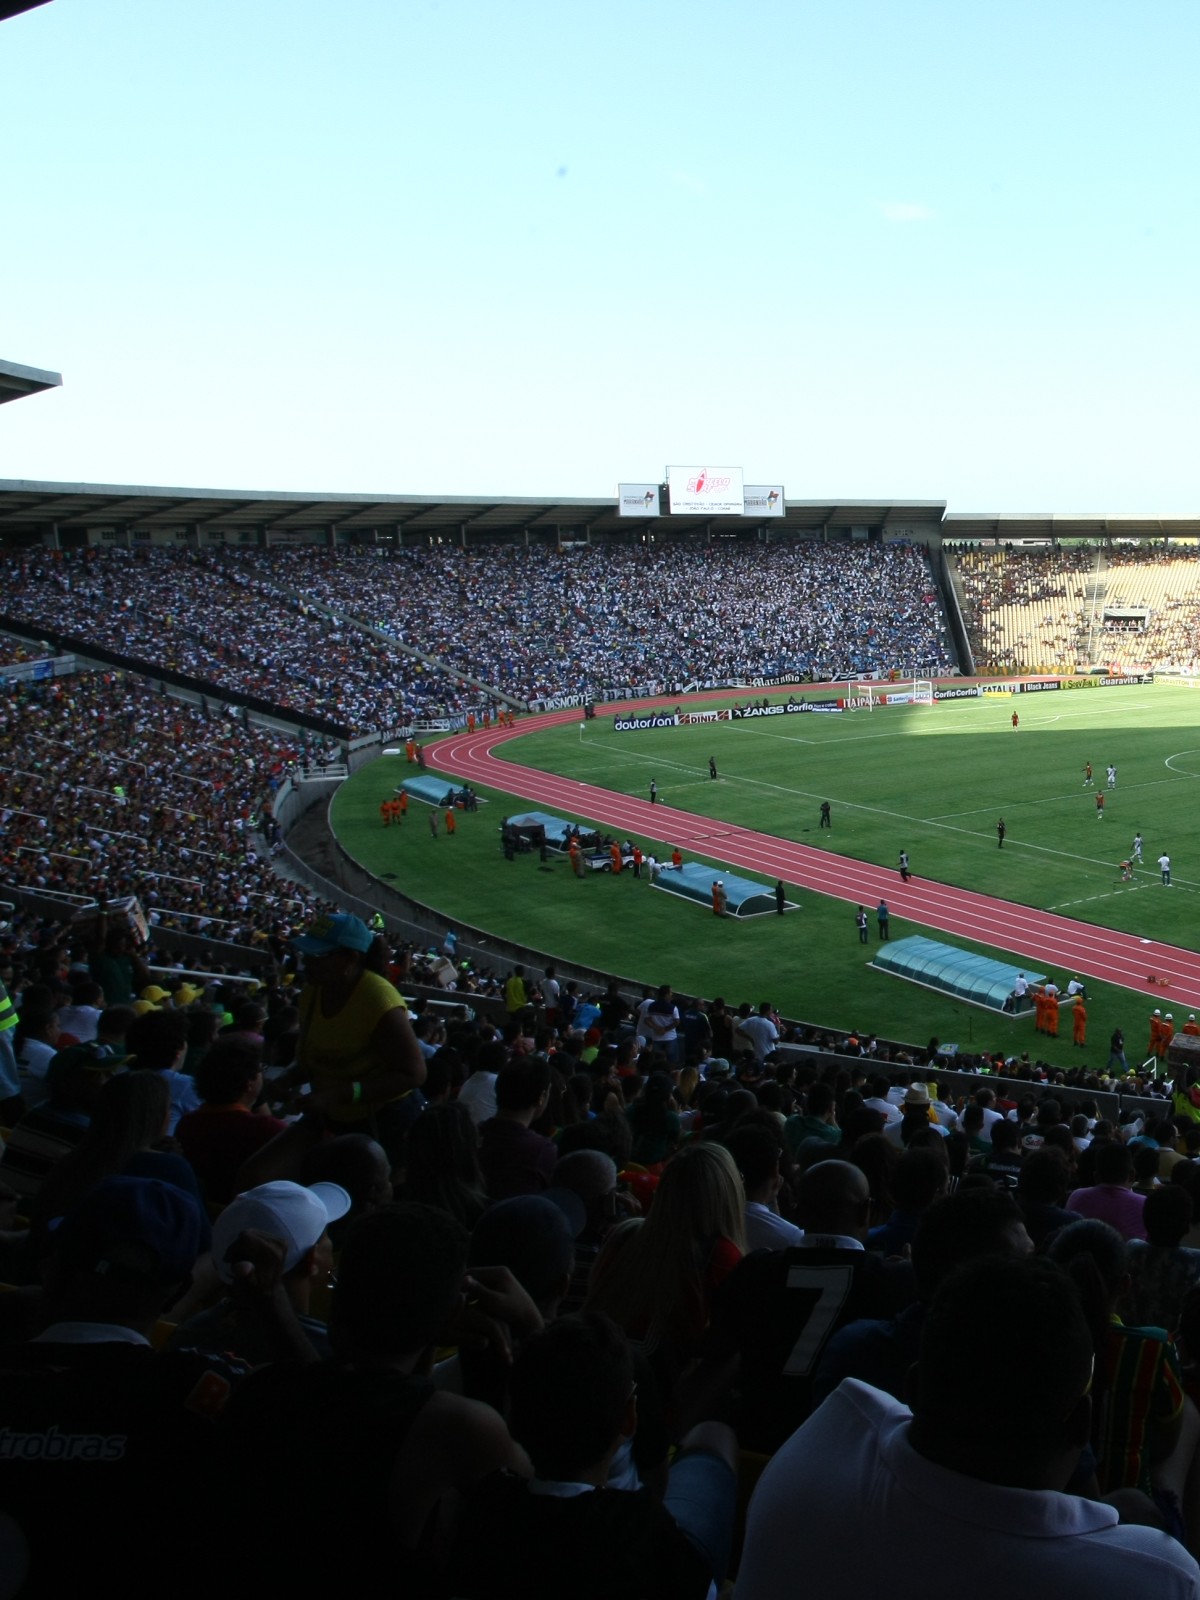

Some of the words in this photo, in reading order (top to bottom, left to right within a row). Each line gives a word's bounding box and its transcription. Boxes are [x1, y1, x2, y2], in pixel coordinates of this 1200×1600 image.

[1027, 682, 1042, 692] Black
[1043, 680, 1058, 690] Jeans
[1099, 676, 1138, 686] Guaravita
[934, 690, 956, 699] Corfio
[956, 688, 977, 697] Corfio
[743, 706, 784, 718] ZANGS
[787, 702, 813, 712] Corfio
[691, 715, 716, 724] DINIZ
[782, 1265, 855, 1377] 7
